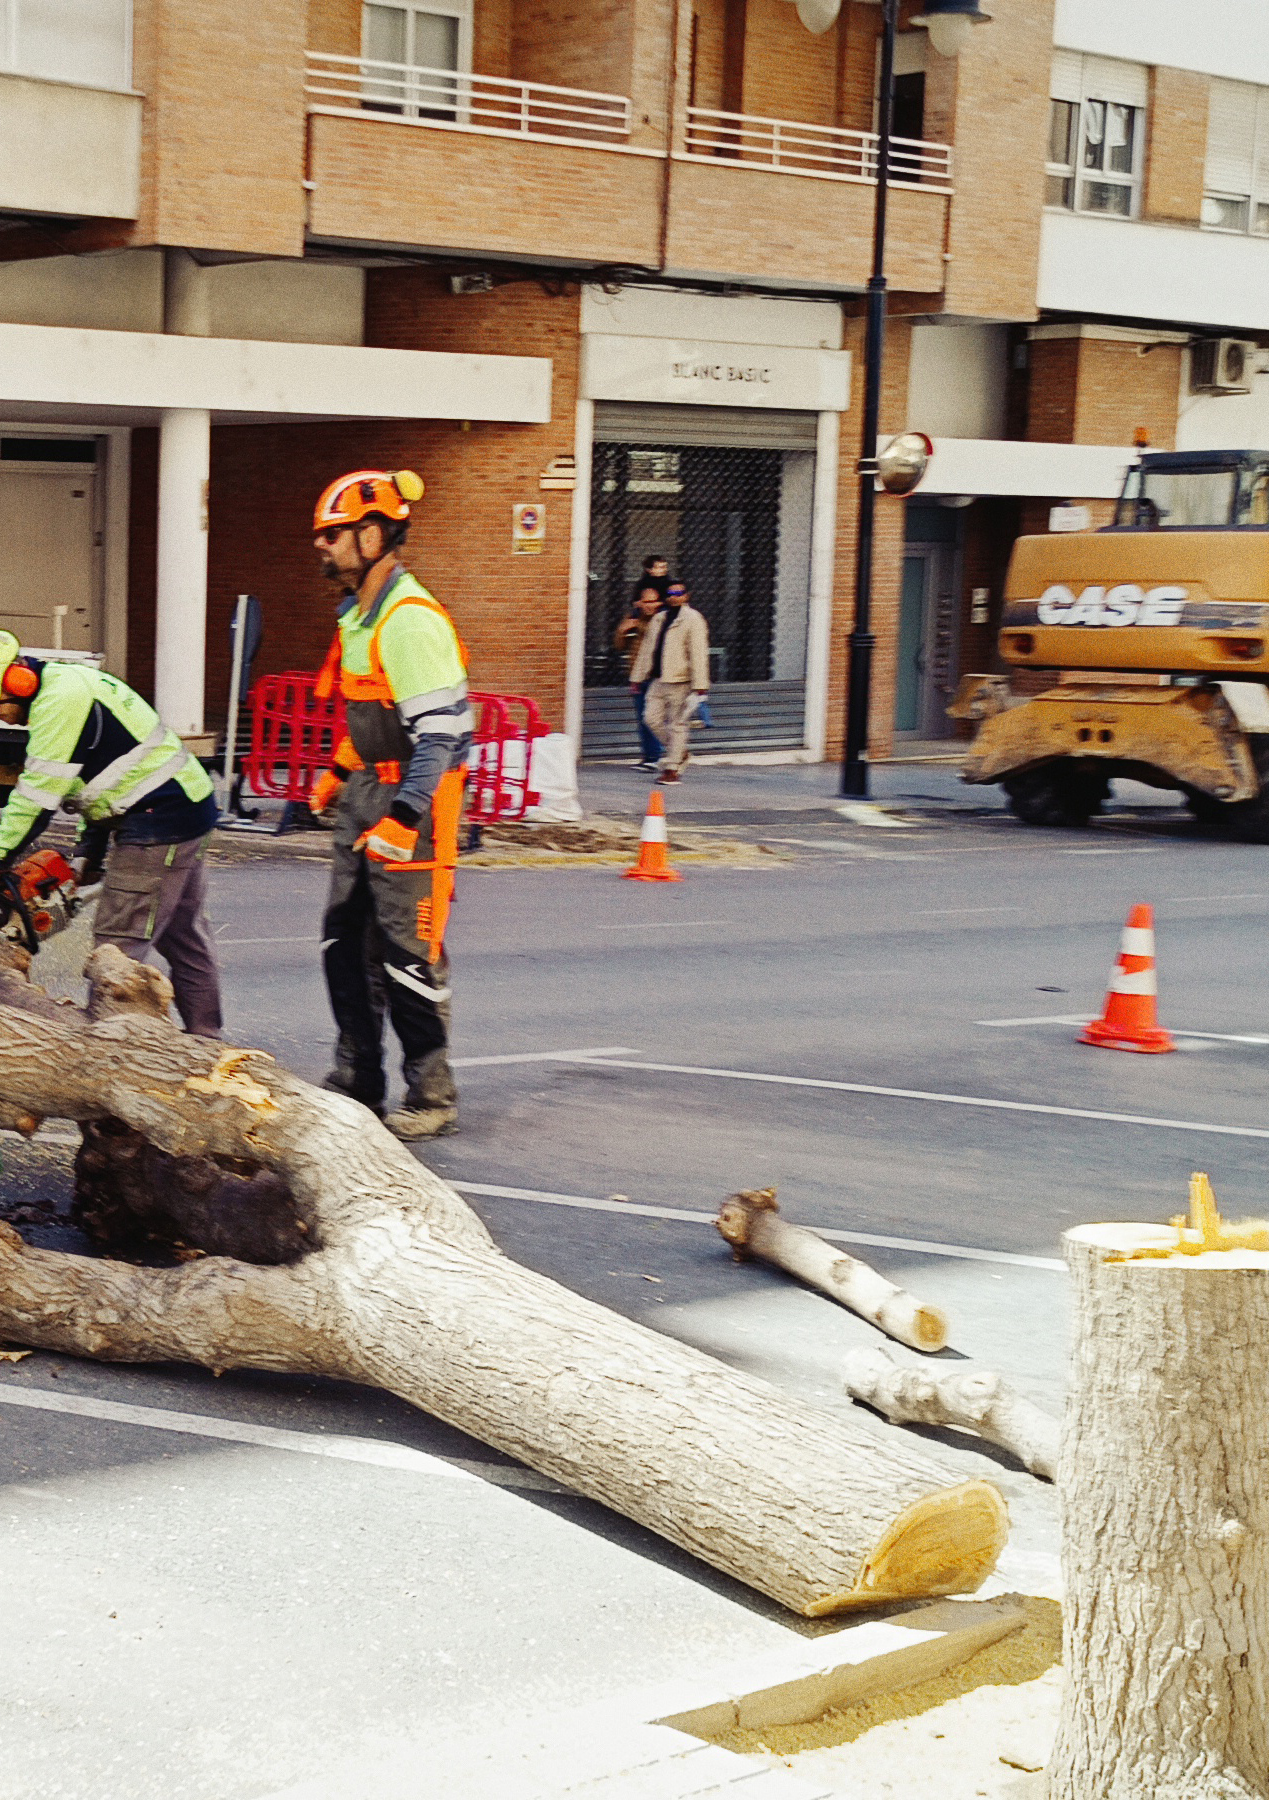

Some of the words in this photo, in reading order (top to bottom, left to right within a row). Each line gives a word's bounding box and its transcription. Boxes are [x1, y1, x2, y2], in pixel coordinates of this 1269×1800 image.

[672, 362, 721, 381] BLANC
[727, 366, 771, 384] BASIC
[1037, 584, 1190, 627] CASE
